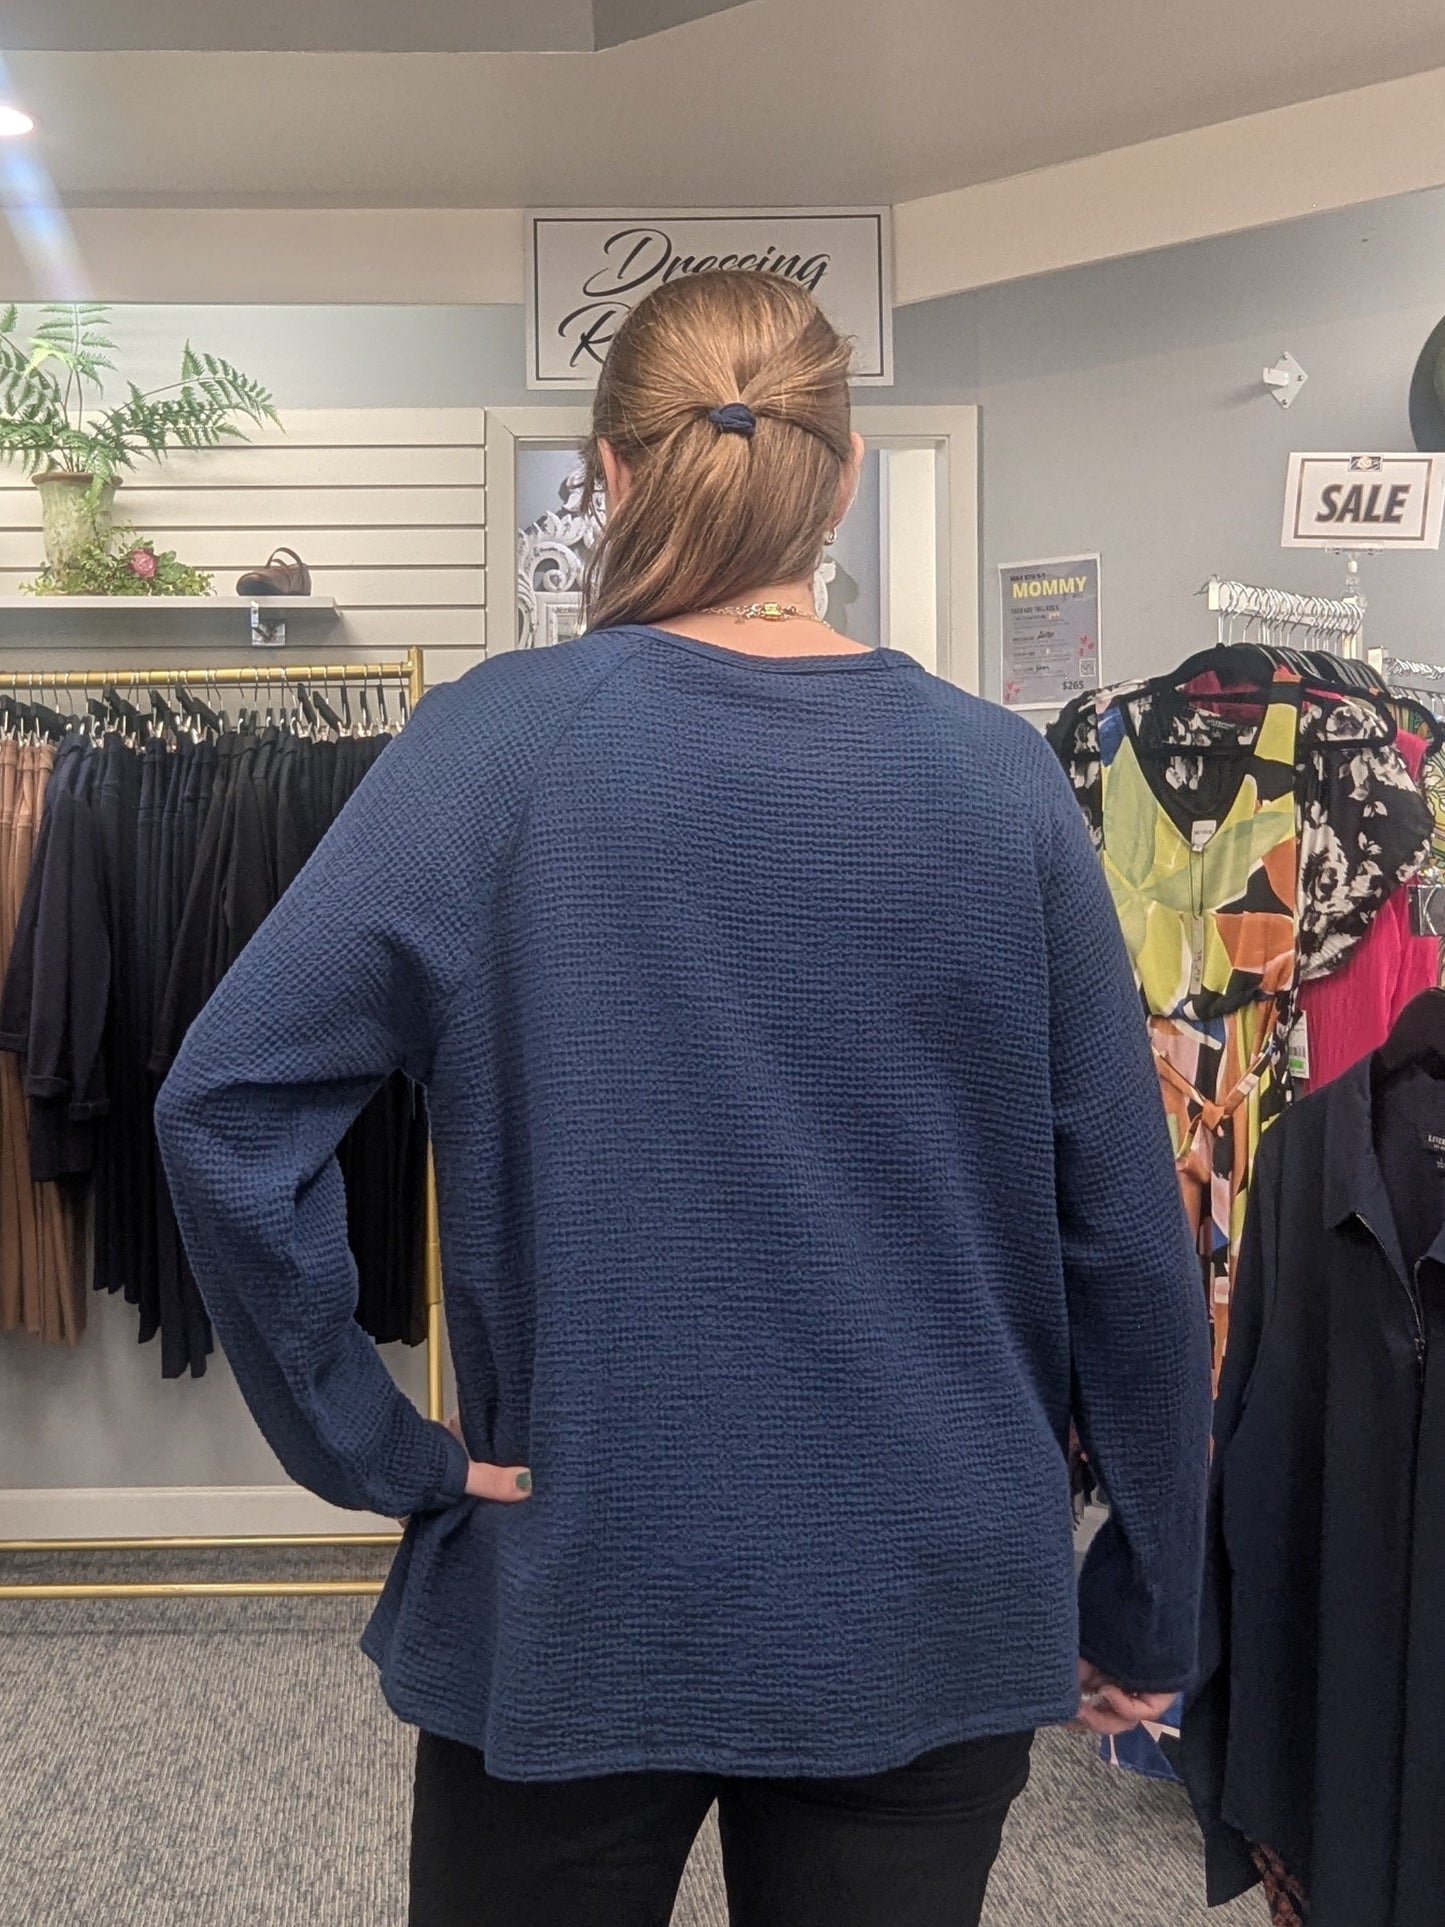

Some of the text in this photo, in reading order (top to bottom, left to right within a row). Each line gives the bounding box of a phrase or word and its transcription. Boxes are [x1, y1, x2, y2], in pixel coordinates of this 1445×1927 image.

[1316, 483, 1411, 523] SALE
[1012, 576, 1087, 598] MOMMY
[1062, 680, 1084, 690] $265
